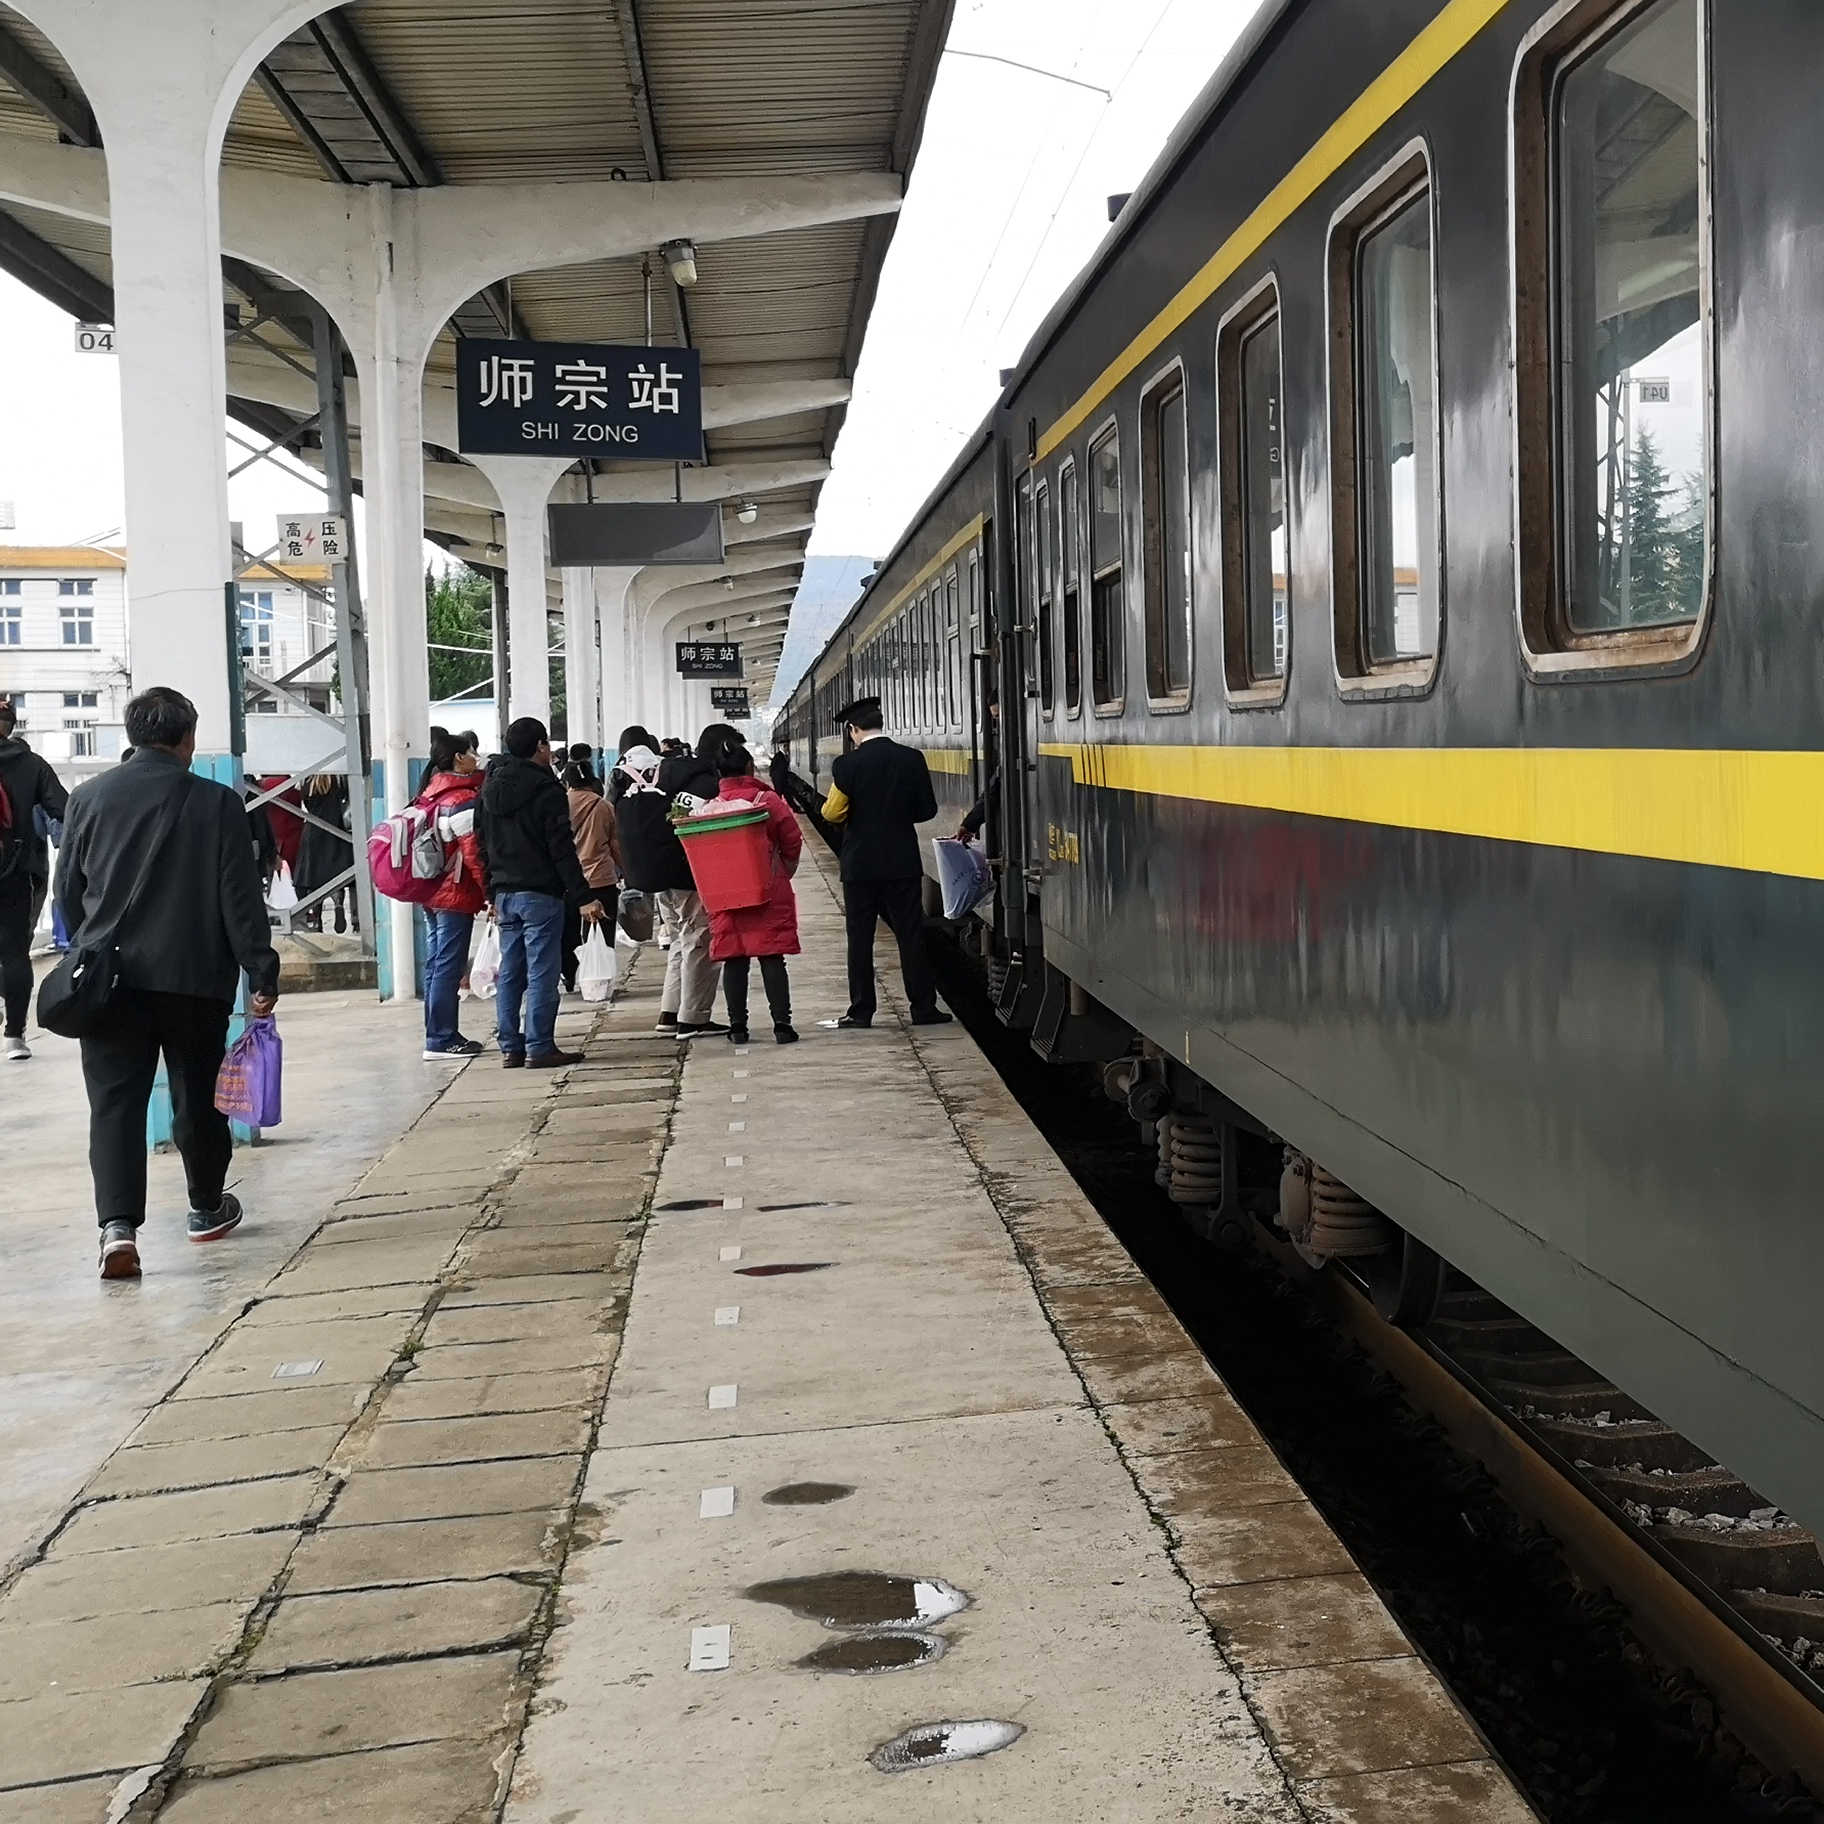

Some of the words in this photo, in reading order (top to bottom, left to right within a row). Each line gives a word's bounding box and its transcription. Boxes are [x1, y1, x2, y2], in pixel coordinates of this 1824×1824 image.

[80, 332, 114, 351] 04
[478, 355, 683, 414] 师宗站
[521, 421, 559, 440] SHI
[572, 423, 639, 443] ZONG
[681, 646, 735, 661] 师宗站
